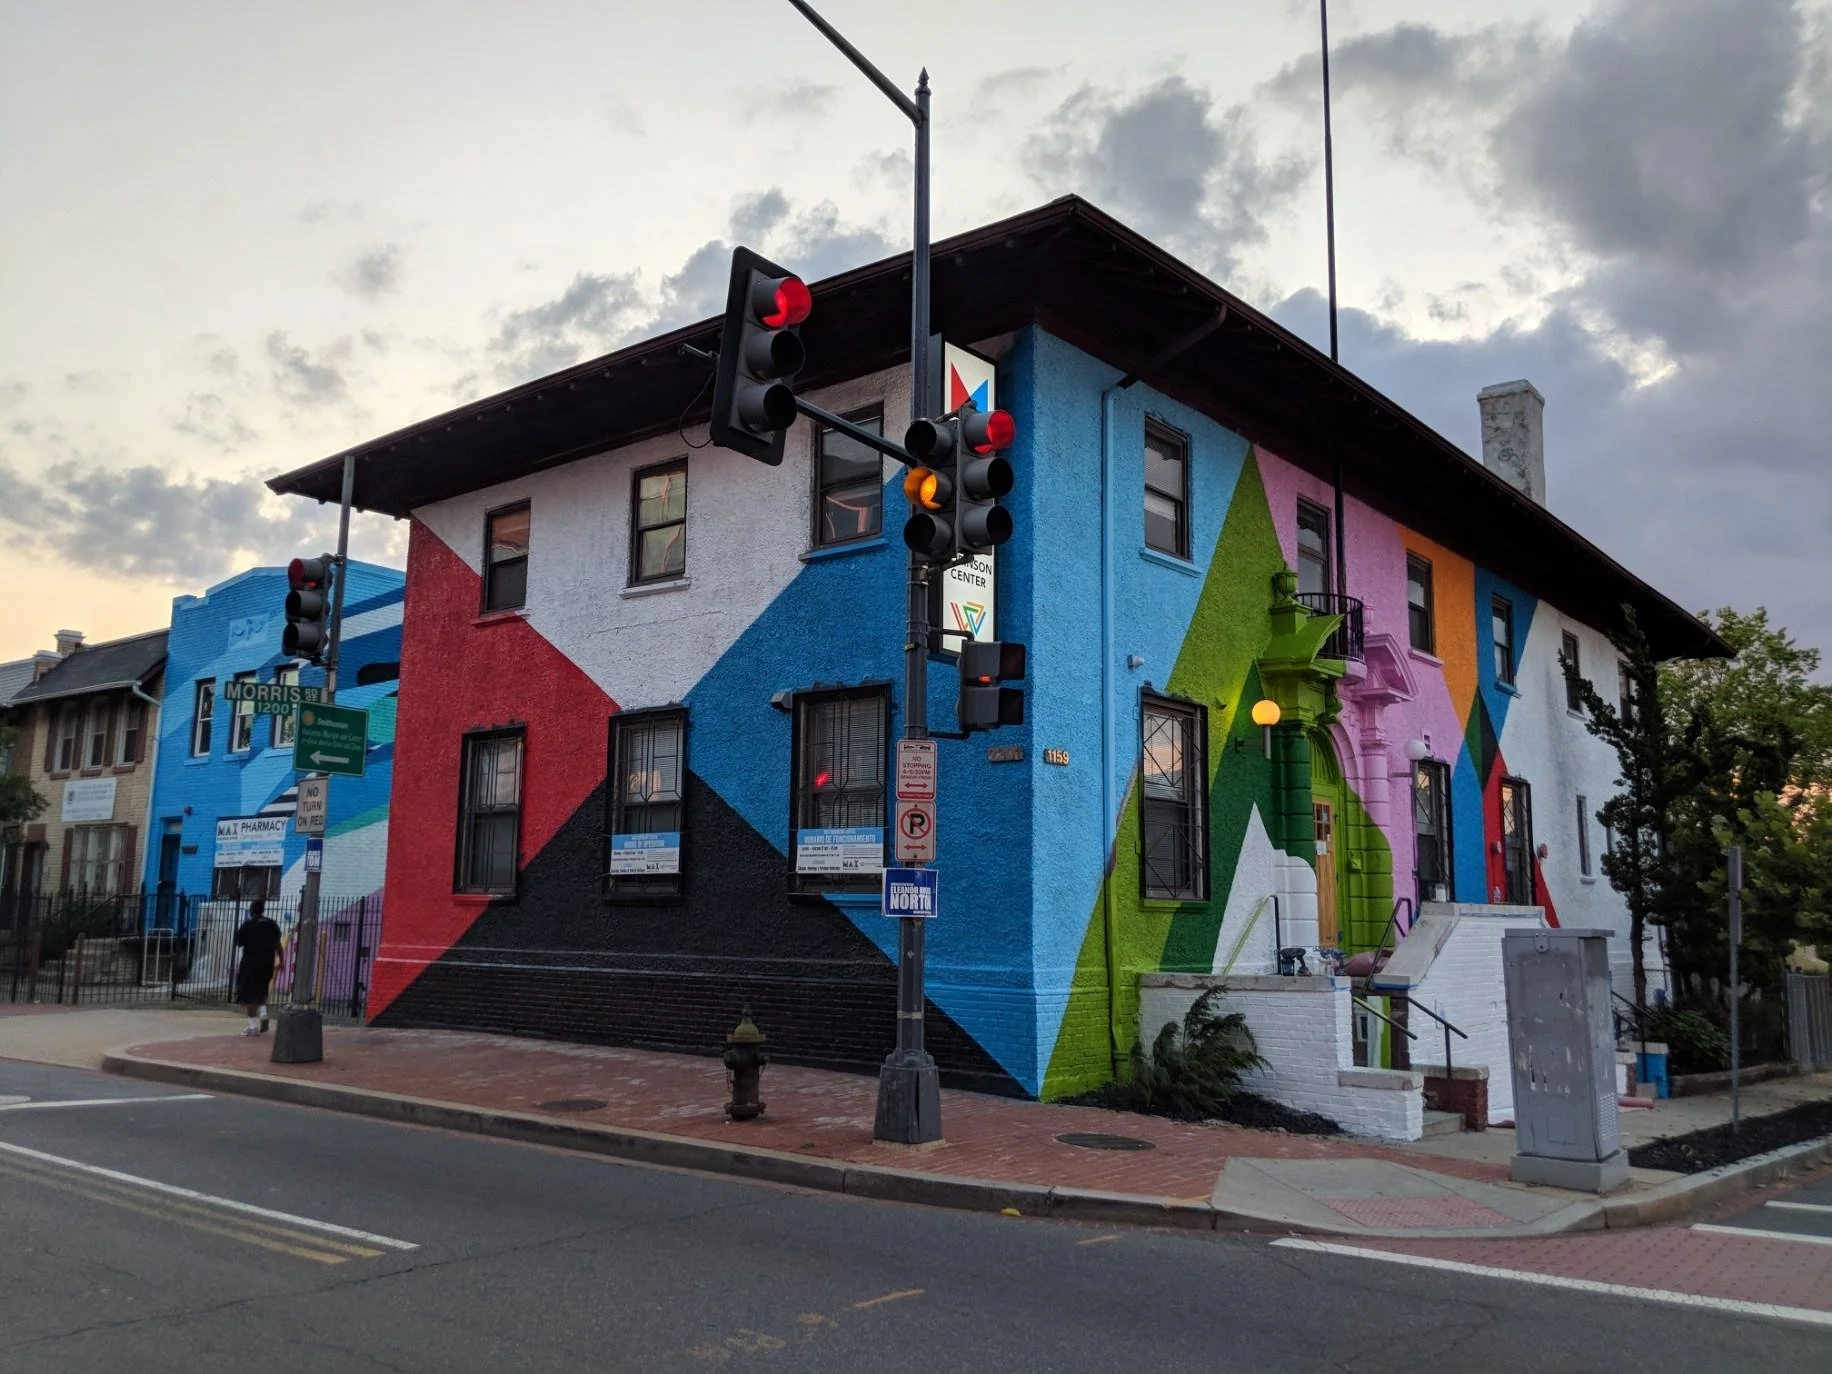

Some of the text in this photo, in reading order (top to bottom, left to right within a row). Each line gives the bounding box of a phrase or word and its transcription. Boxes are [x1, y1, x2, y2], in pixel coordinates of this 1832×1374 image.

[950, 568, 986, 588] CENTER
[226, 683, 318, 702] MORRIS RD
[258, 702, 290, 714] 1200
[1047, 749, 1069, 764] 1159
[306, 787, 319, 797] NO
[302, 801, 322, 812] TURN
[240, 820, 286, 833] PHARMACY
[297, 815, 323, 826] ON RED
[890, 886, 918, 894] ELEANOR
